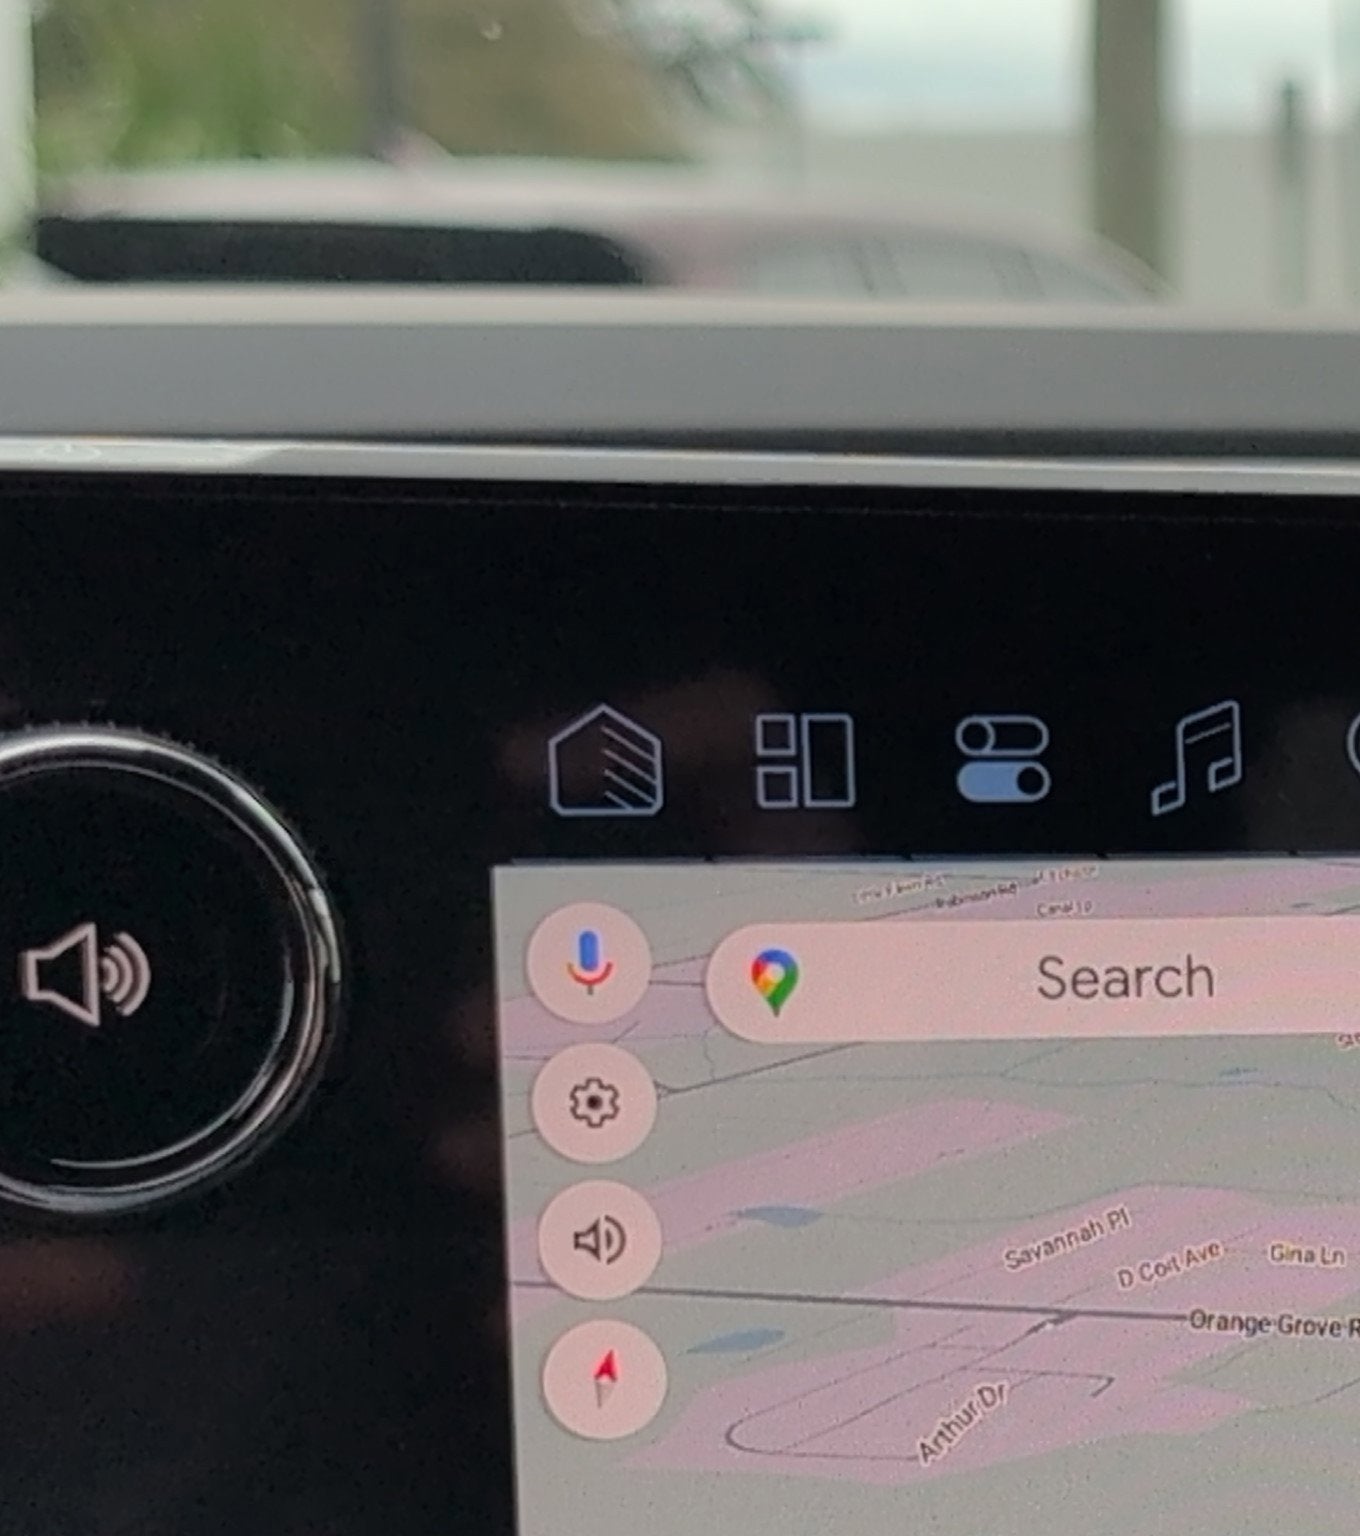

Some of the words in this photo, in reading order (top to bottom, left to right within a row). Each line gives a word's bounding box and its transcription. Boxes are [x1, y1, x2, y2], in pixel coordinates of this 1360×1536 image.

[1036, 954, 1217, 1002] Search
[1003, 1217, 1105, 1271] Savannah
[1118, 1268, 1134, 1290] D
[1183, 1242, 1221, 1269] Ave
[1270, 1244, 1315, 1265] Gina
[1320, 1246, 1346, 1265] Ln
[1189, 1309, 1275, 1336] Orange
[1277, 1316, 1344, 1338] Grove
[917, 1402, 979, 1464] Arthur
[976, 1382, 1006, 1416] Dr
